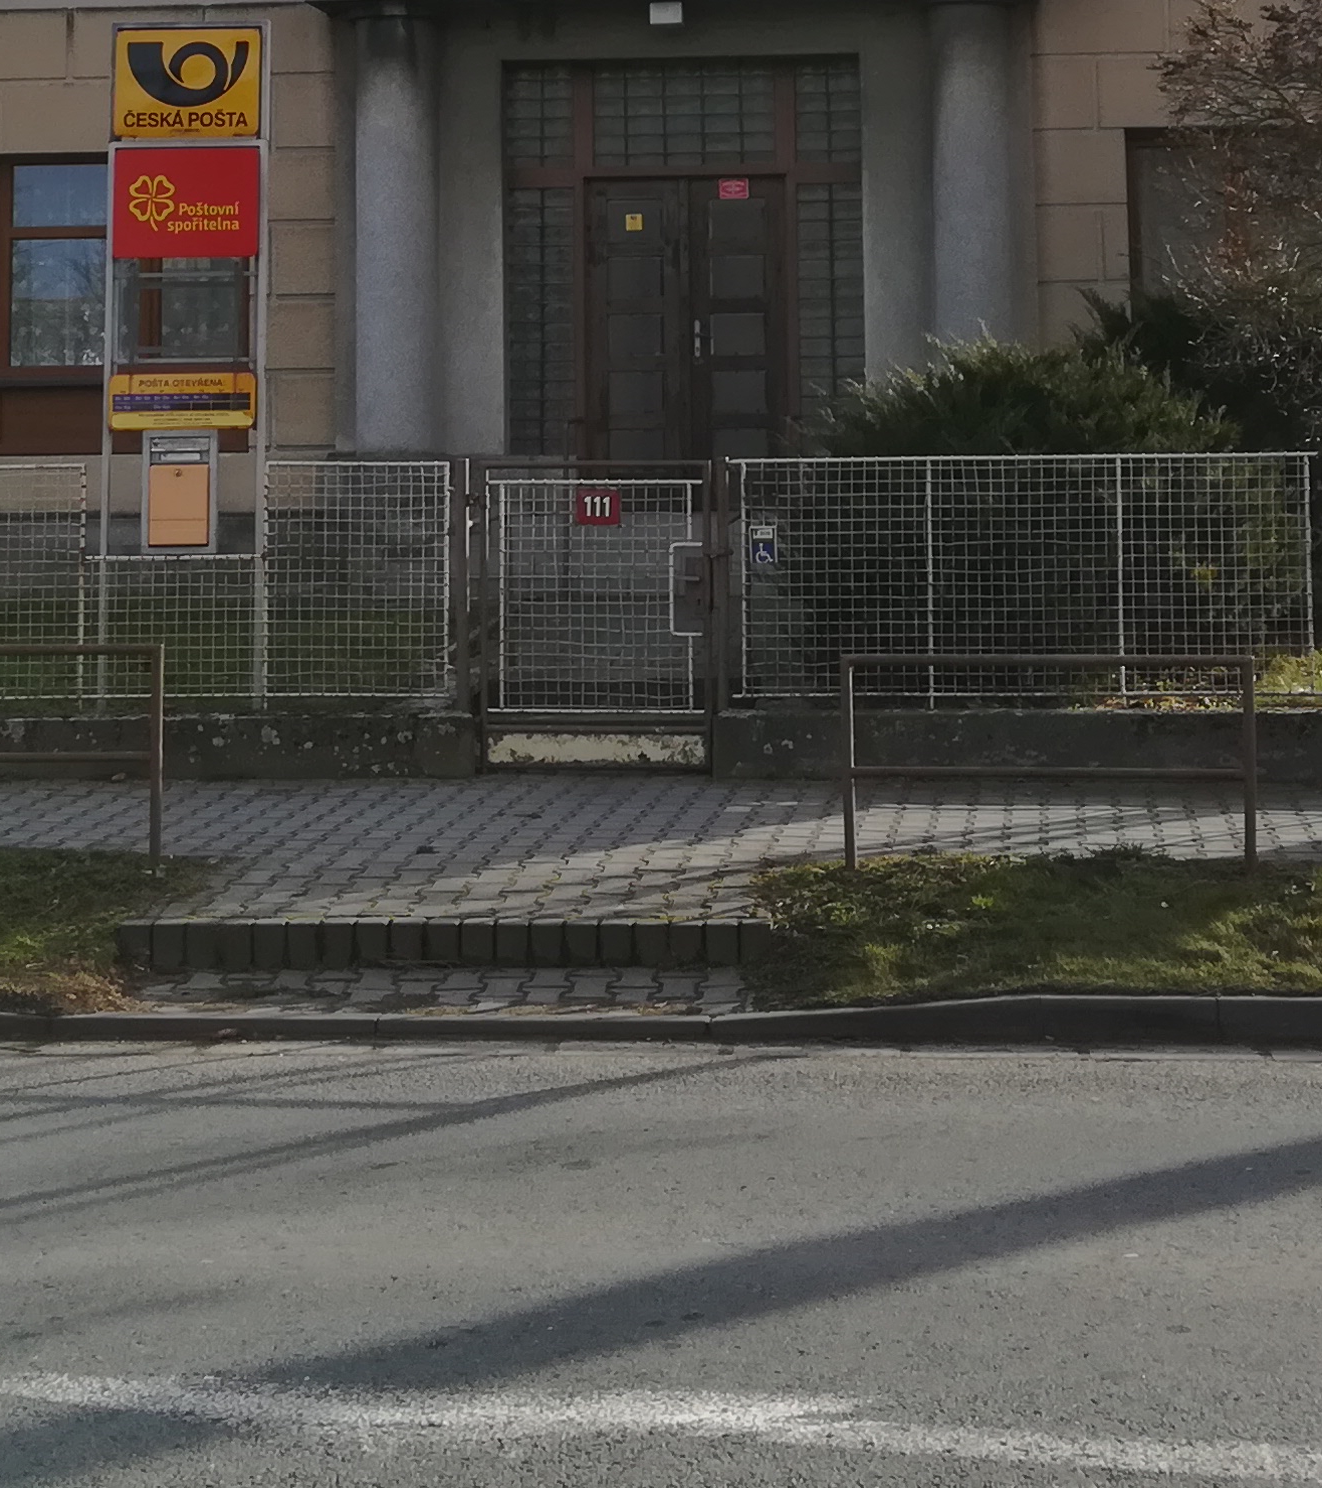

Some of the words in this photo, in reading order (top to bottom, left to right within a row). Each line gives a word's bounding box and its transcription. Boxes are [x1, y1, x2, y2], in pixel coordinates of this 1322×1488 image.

[123, 109, 184, 128] ČESKÁ
[188, 109, 248, 128] POŠTA
[178, 201, 240, 216] Poštovní
[167, 217, 240, 234] spořitelna
[138, 377, 170, 388] POŠTA
[172, 377, 224, 387] OTEVŘENA
[583, 496, 611, 517] 111
